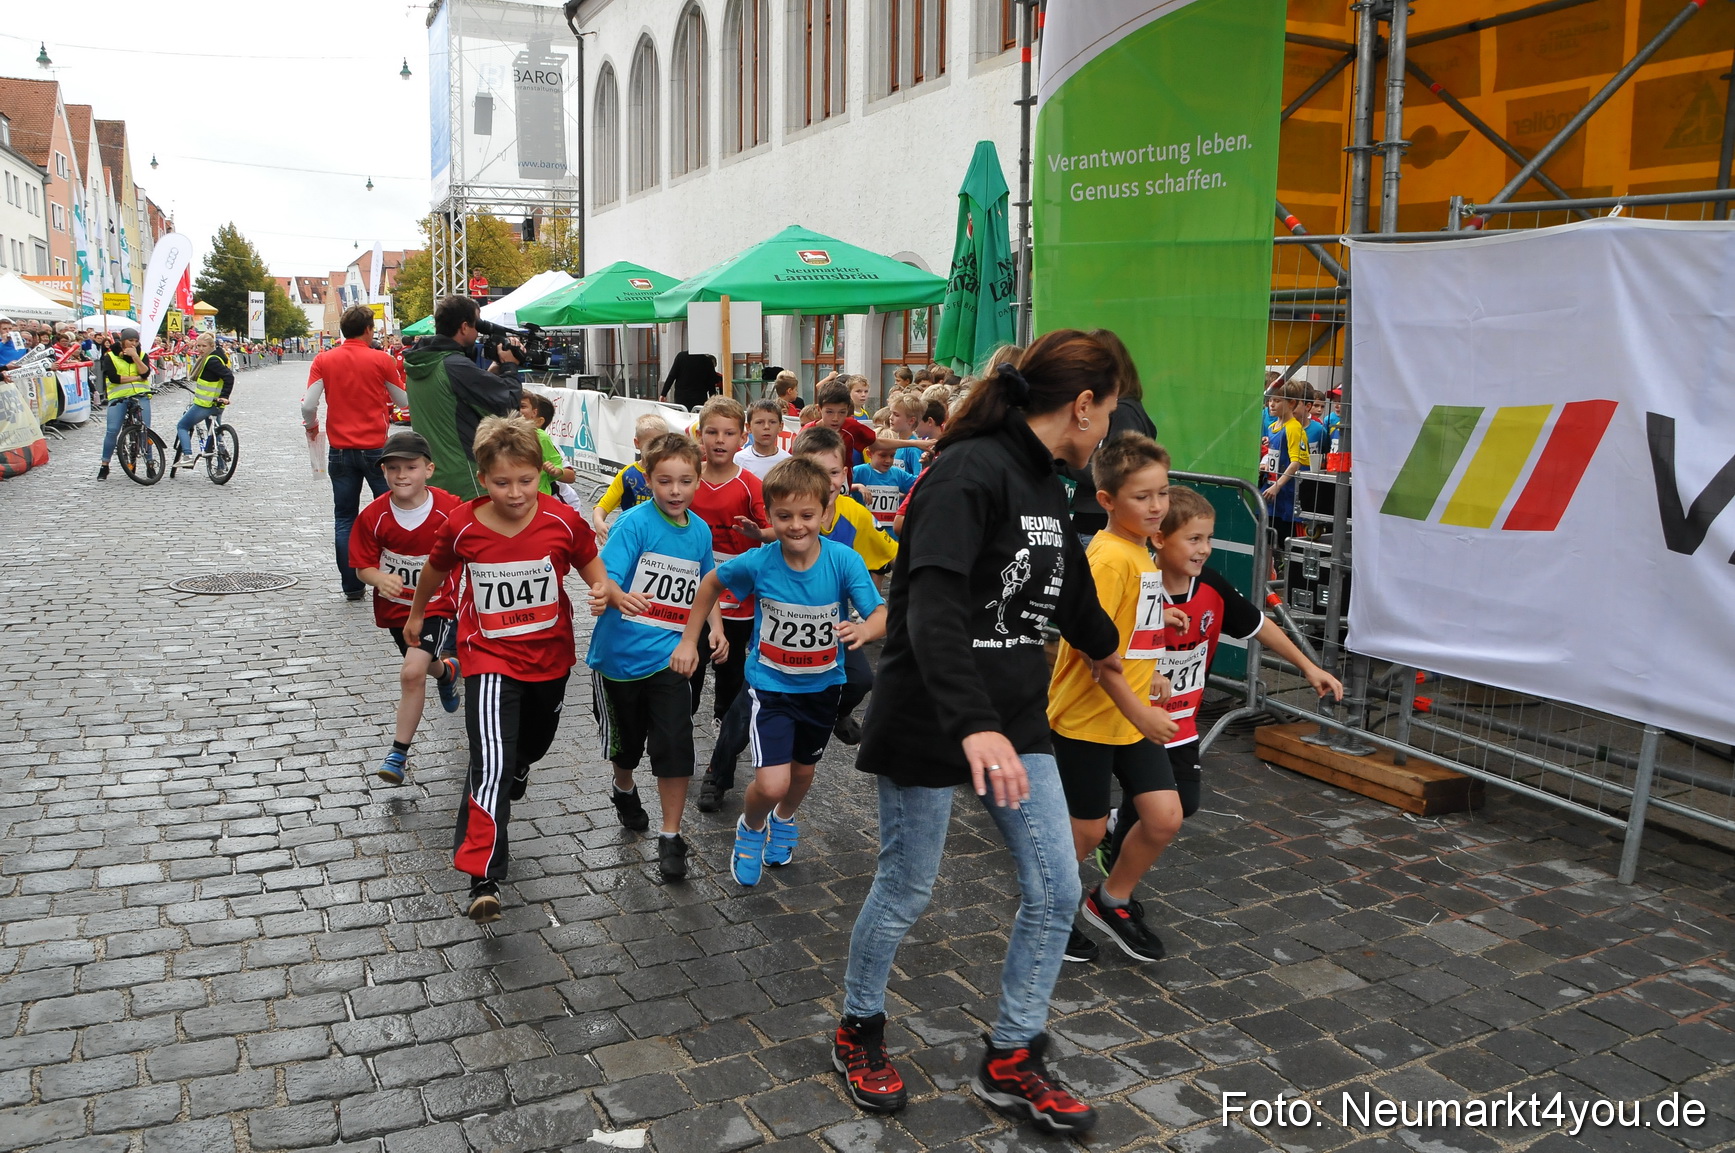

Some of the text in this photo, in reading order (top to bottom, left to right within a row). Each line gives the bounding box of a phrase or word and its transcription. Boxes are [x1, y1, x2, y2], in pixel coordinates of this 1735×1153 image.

[1048, 132, 1252, 173] Verantwortung leben.
[1070, 168, 1227, 202] Genuss schaffen.
[774, 272, 879, 282] Lammsbräu
[149, 276, 168, 322] Audi BKK
[170, 317, 179, 328] A
[1645, 411, 1735, 566] V
[472, 567, 542, 579] PARTL Neumarkt
[640, 558, 666, 570] PARTL
[478, 576, 550, 610] 7047
[642, 570, 697, 606] 7036
[501, 610, 536, 626] Lukas
[648, 606, 678, 621] Julian
[762, 602, 828, 620] PARTL Neumarkt
[1145, 593, 1165, 626] 71
[768, 614, 834, 648] 7233
[972, 638, 1003, 648] Danke
[782, 653, 813, 665] Louis
